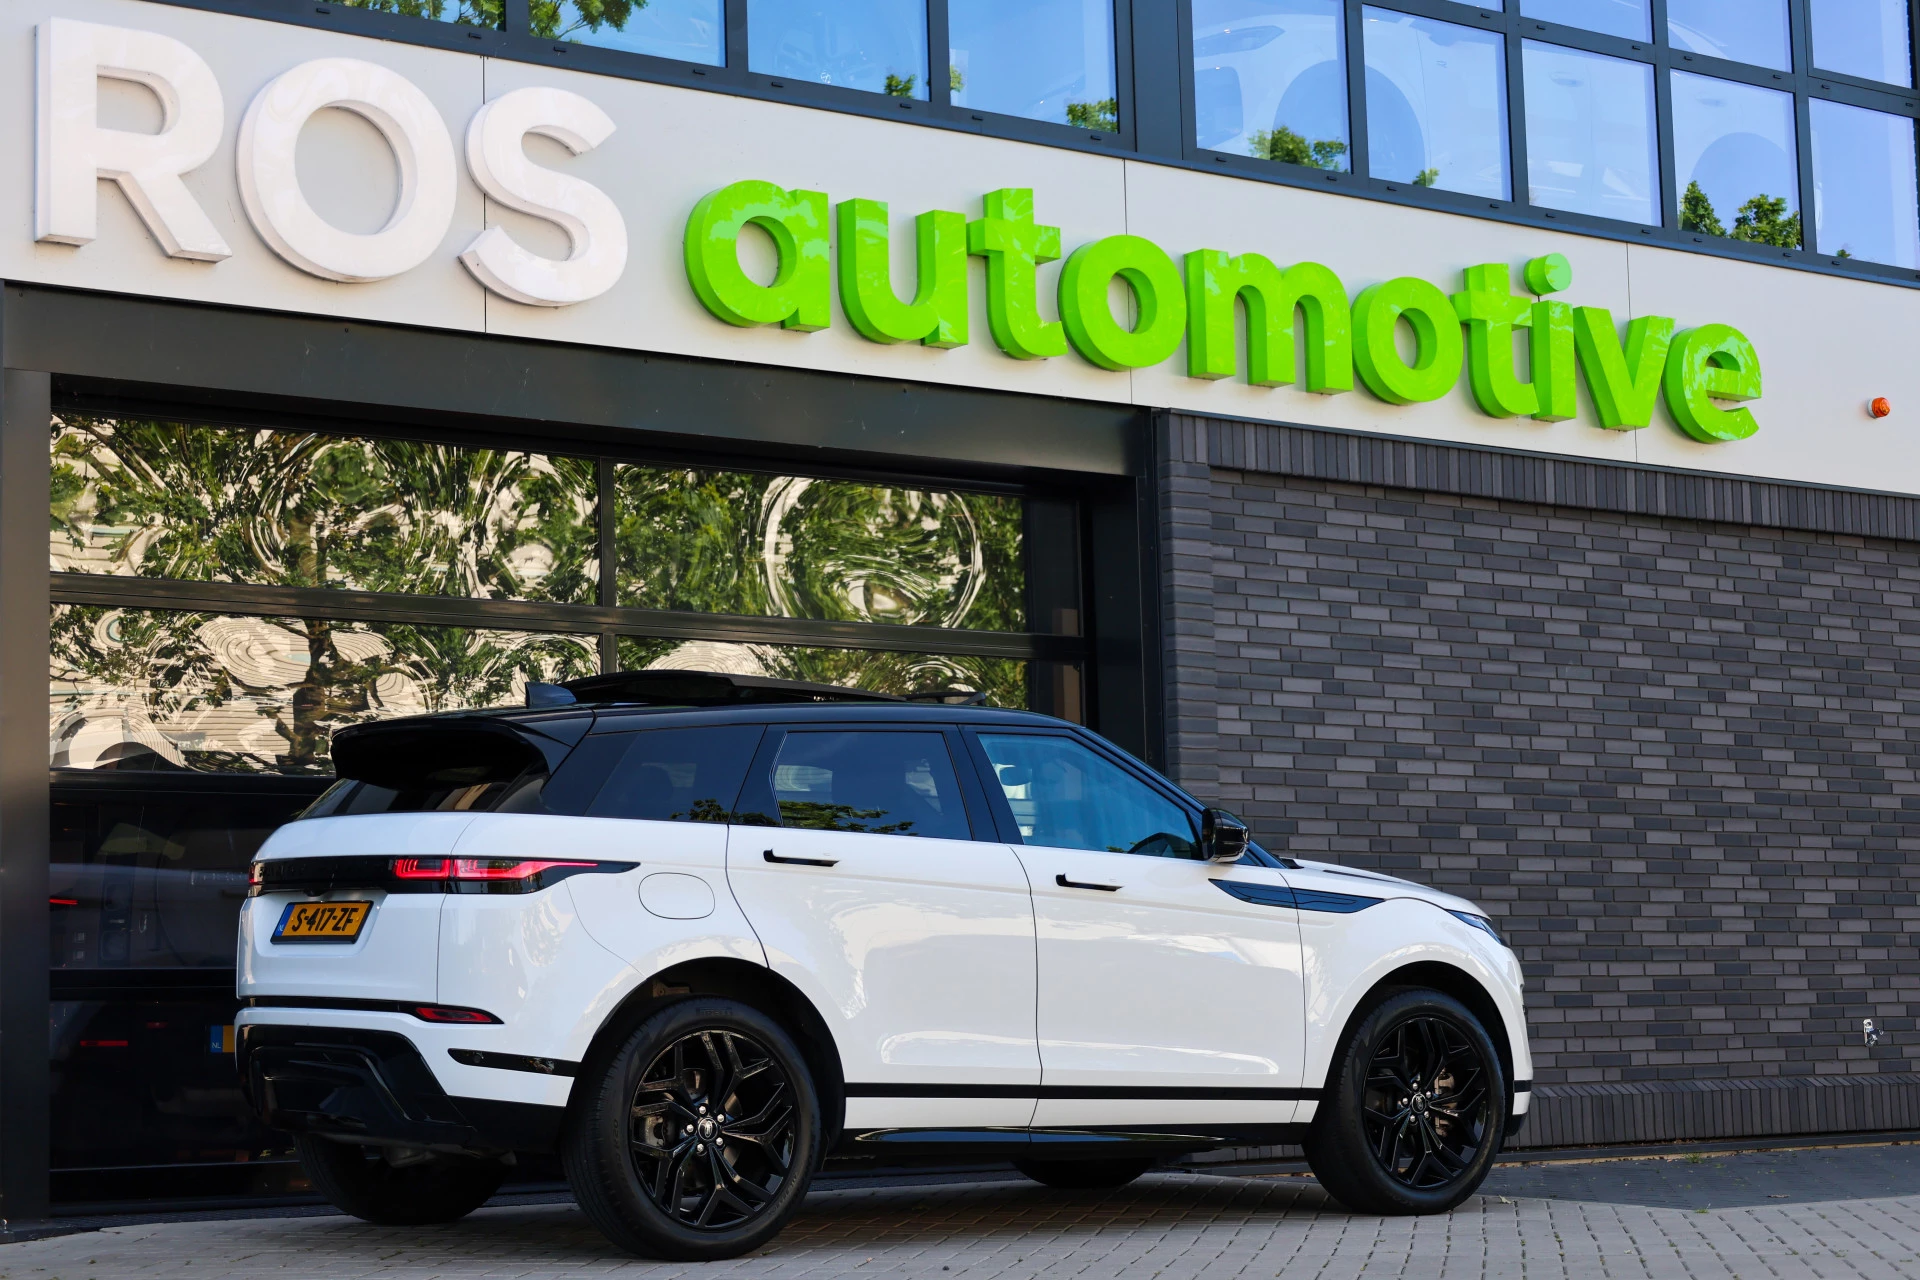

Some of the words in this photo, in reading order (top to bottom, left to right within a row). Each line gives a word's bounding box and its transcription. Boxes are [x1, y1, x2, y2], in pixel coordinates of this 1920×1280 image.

[34, 16, 628, 308] ROS
[684, 179, 1763, 444] automotive
[291, 907, 359, 932] S-417-ZF
[211, 1041, 221, 1049] NL
